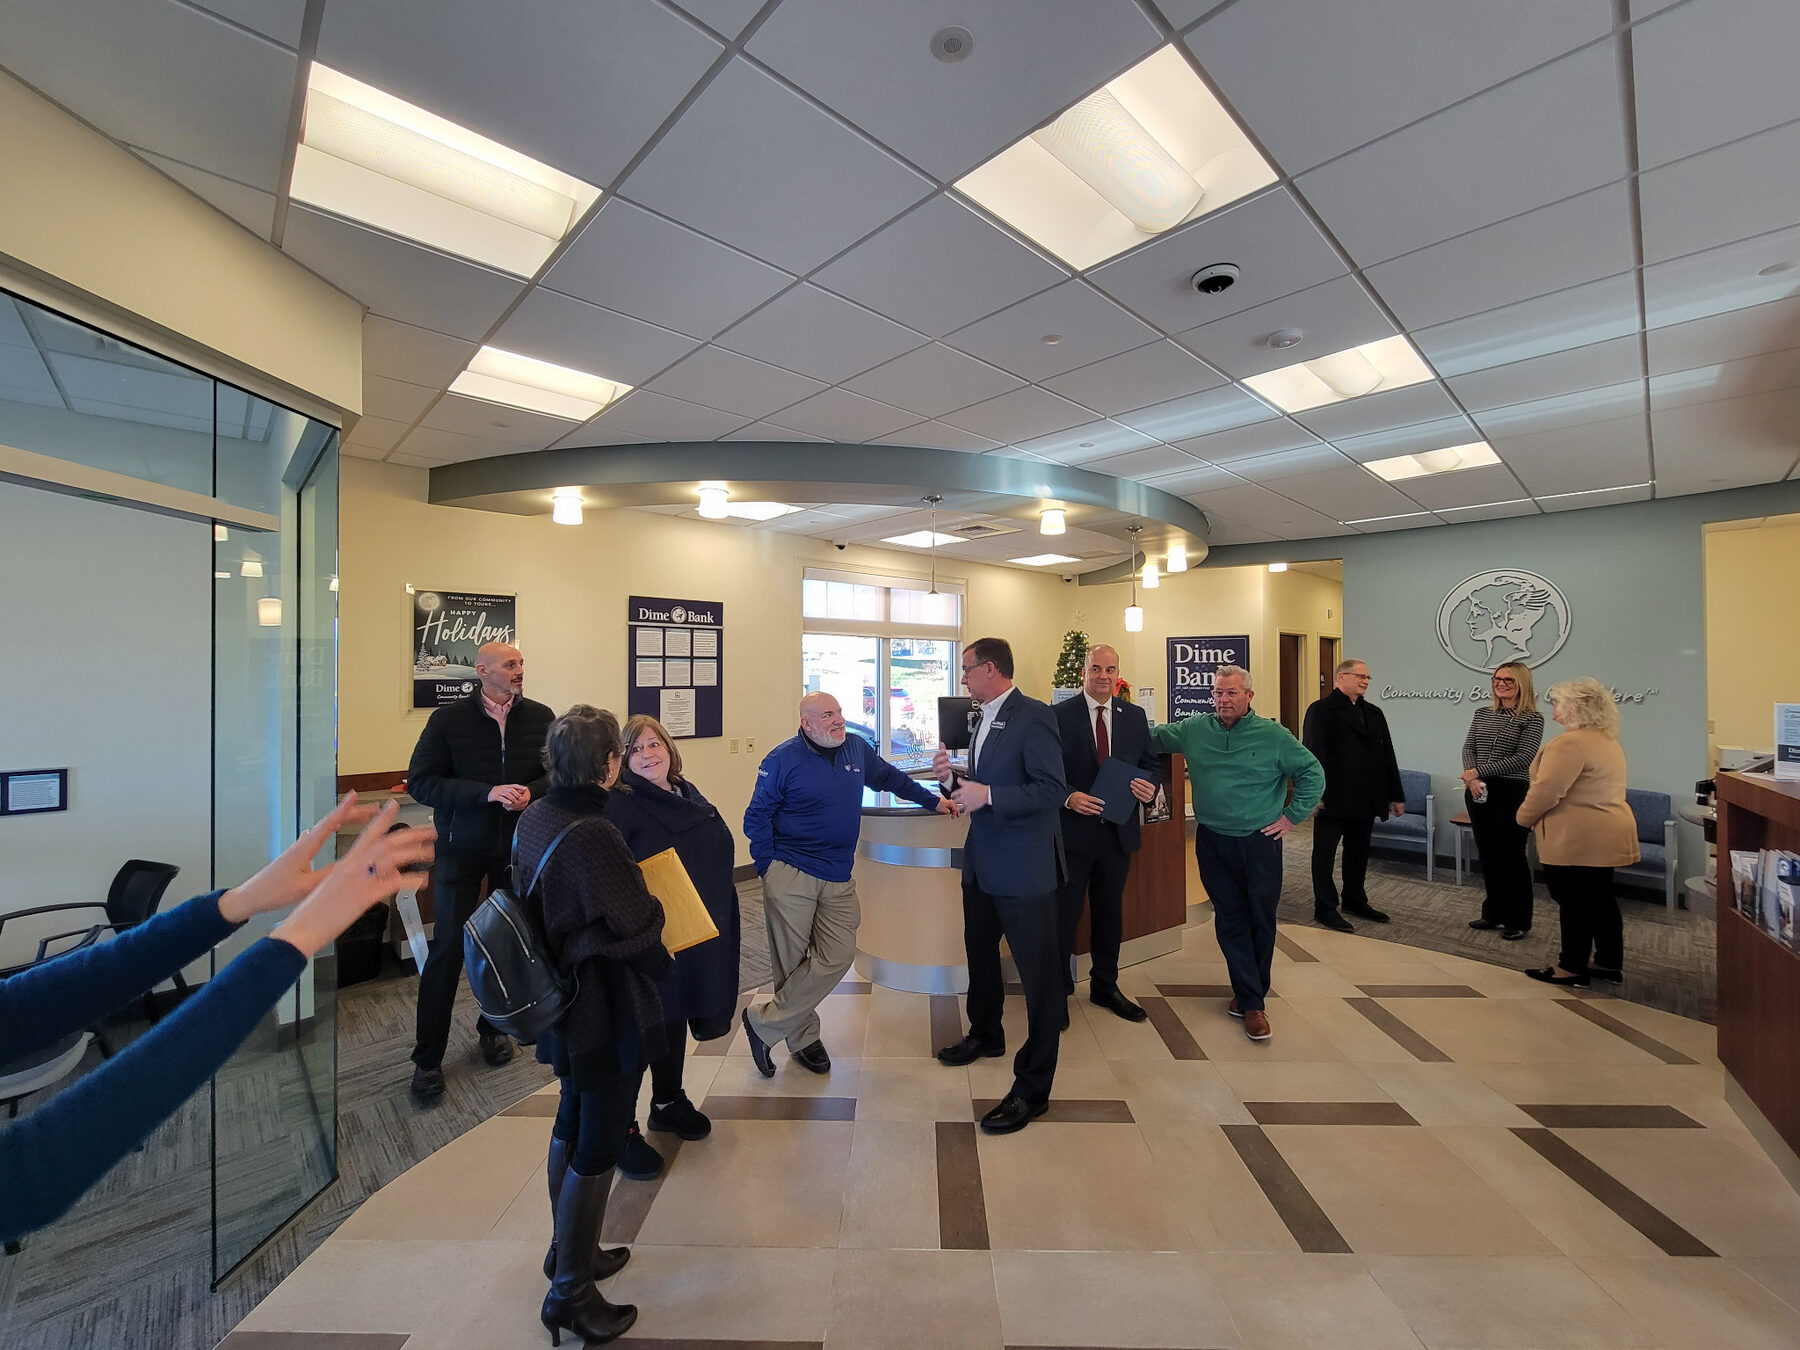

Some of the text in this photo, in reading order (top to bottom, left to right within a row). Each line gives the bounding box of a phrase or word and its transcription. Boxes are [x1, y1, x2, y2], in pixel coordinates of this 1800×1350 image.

[638, 607, 715, 624] Dime Bank
[416, 610, 515, 646] Holidays
[1174, 643, 1236, 663] Dime
[1174, 665, 1219, 686] Ban
[435, 684, 460, 693] Dime
[1381, 684, 1464, 704] Community
[1174, 695, 1217, 707] Community
